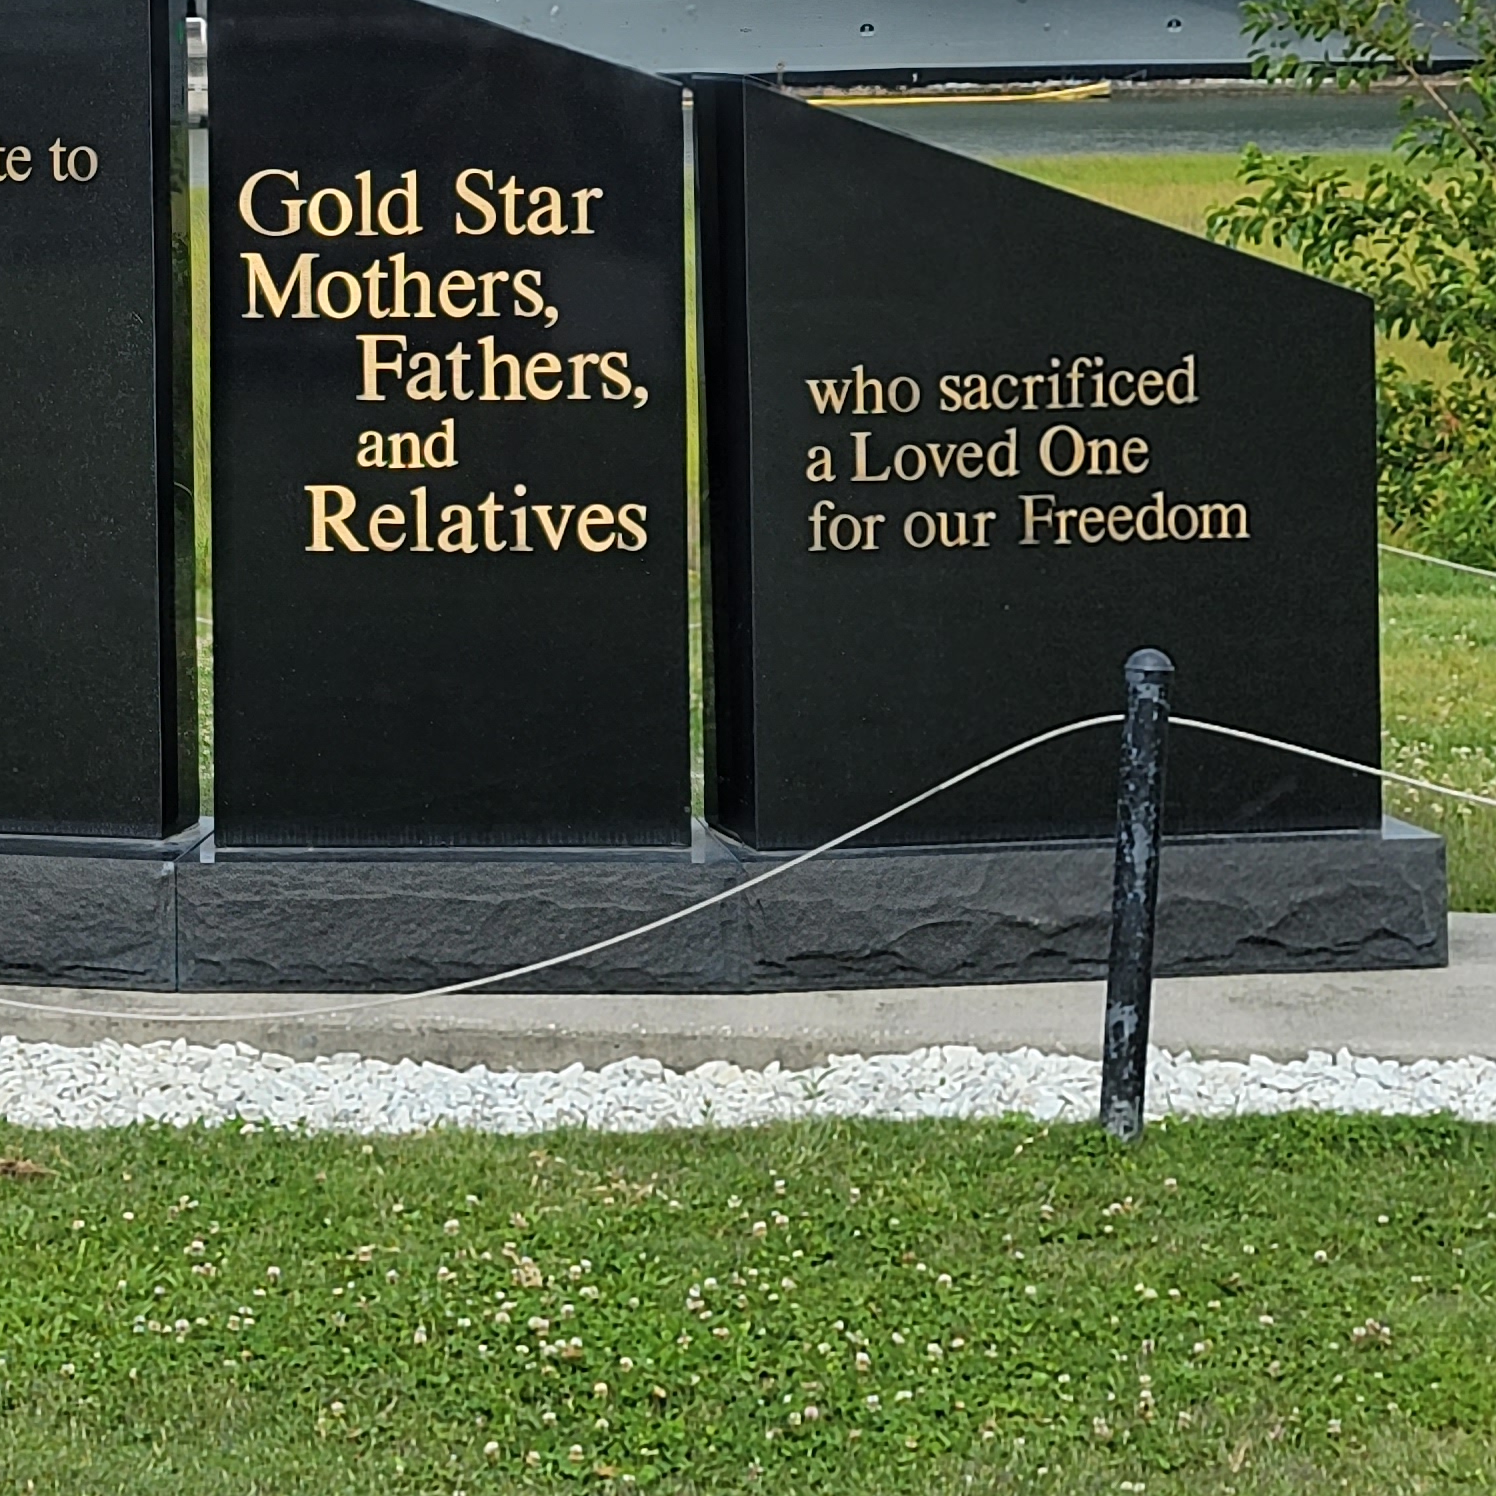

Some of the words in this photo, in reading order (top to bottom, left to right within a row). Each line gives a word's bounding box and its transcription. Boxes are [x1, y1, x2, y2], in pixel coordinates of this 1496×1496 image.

[48, 137, 98, 183] to
[238, 168, 424, 237] Gold
[455, 168, 605, 237] Star
[239, 251, 560, 329] Mothers,
[355, 334, 650, 409] Fathers,
[805, 364, 922, 415] who
[939, 354, 1200, 412] sacrificed
[356, 417, 460, 470] and
[805, 445, 837, 483] a
[849, 427, 1021, 482] Loved
[1039, 424, 1151, 478] One
[304, 483, 649, 553] Relatives
[807, 499, 886, 552] for
[903, 511, 998, 548] our
[1019, 490, 1251, 546] Freedom
